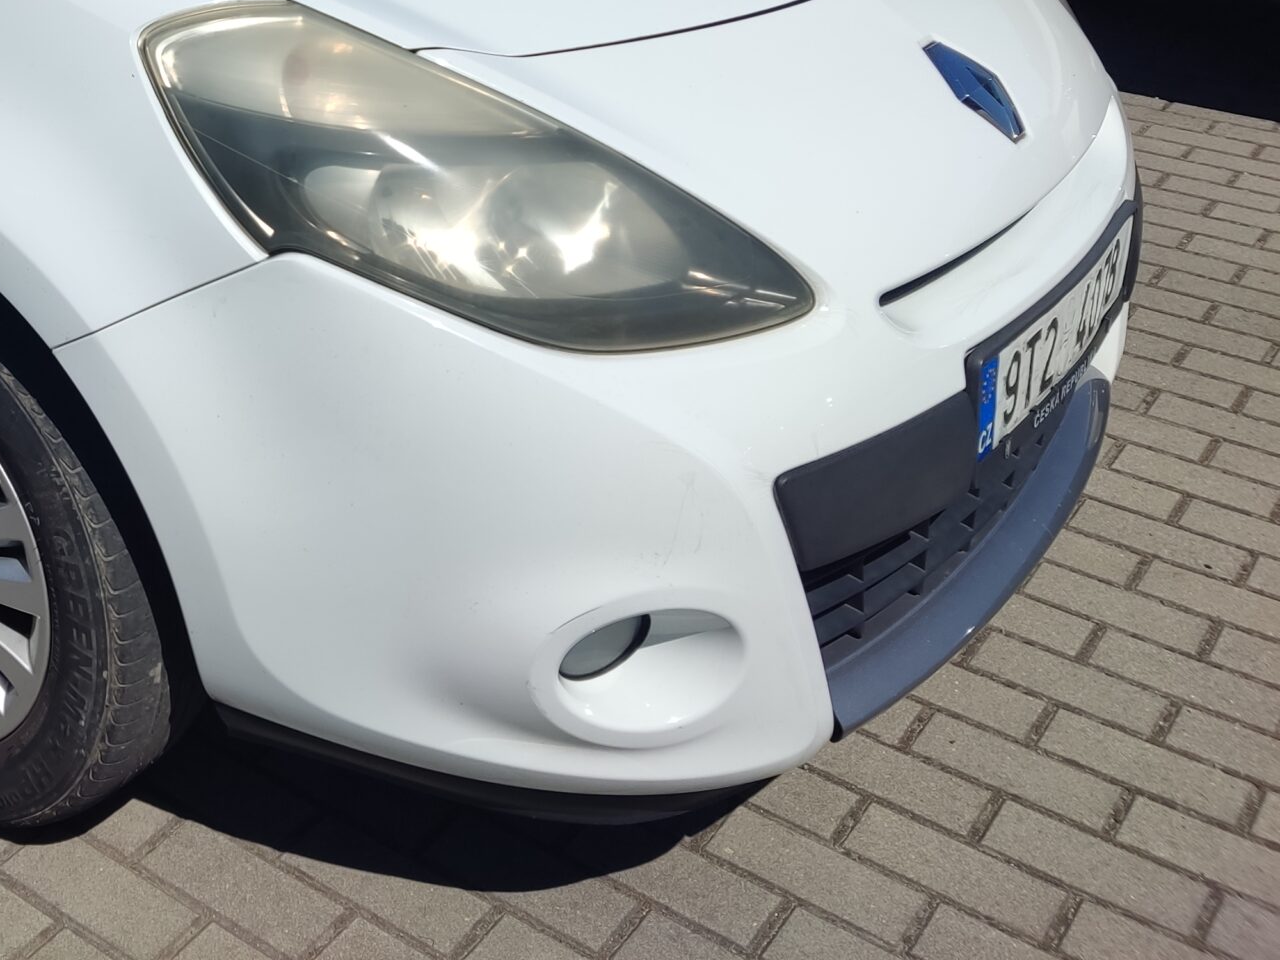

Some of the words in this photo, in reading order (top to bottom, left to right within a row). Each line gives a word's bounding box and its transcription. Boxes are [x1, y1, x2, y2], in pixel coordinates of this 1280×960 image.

[1004, 317, 1058, 425] 9T2
[1033, 389, 1061, 428] ČESKÁ
[978, 422, 993, 453] CZ
